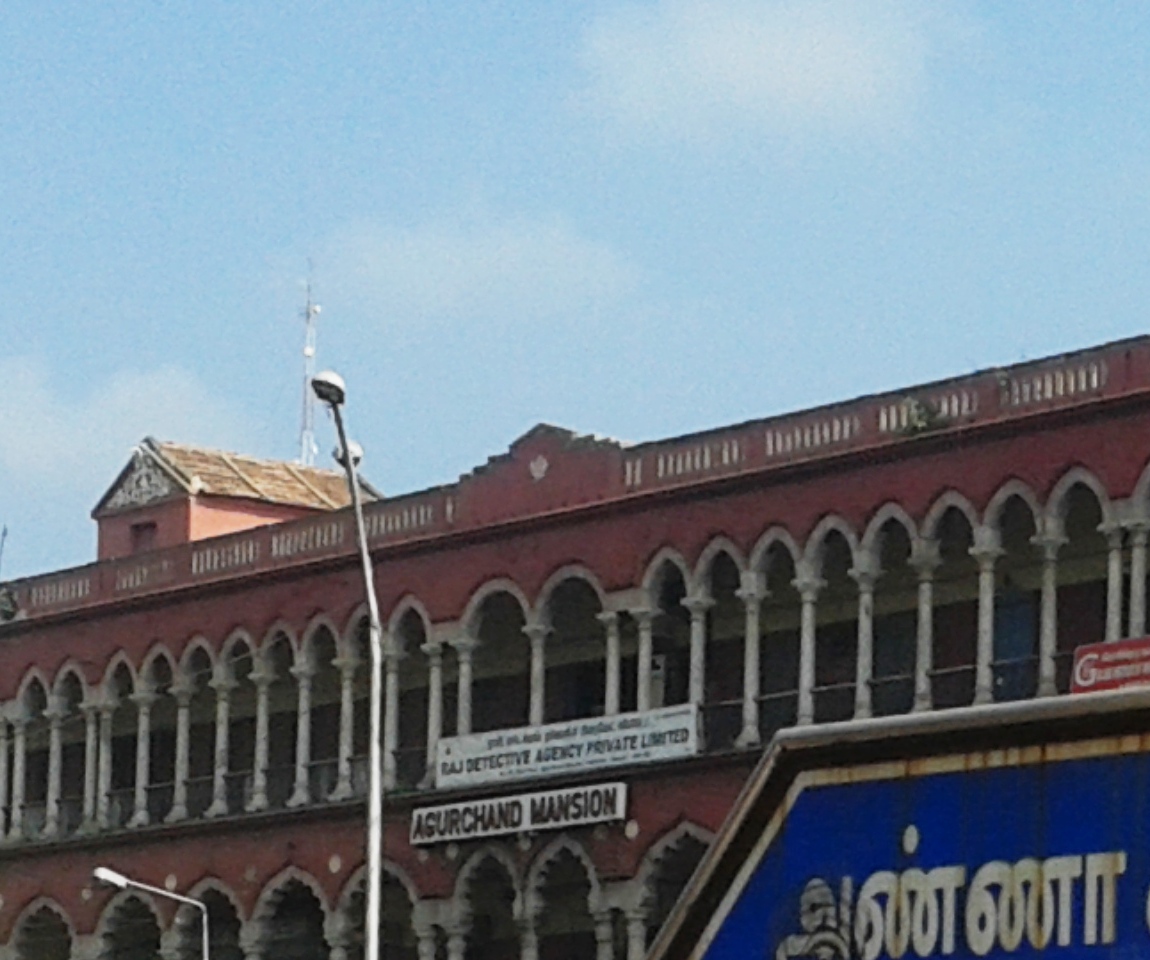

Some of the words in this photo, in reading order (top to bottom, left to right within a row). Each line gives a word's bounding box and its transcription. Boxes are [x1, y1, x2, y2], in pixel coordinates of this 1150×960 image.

[441, 760, 463, 776] RAJ
[466, 749, 531, 773] DETECTIVE
[536, 742, 583, 763] AGENCY
[587, 735, 637, 756] PRIVATE
[641, 727, 690, 750] LIMITED
[530, 787, 617, 824] MANSION
